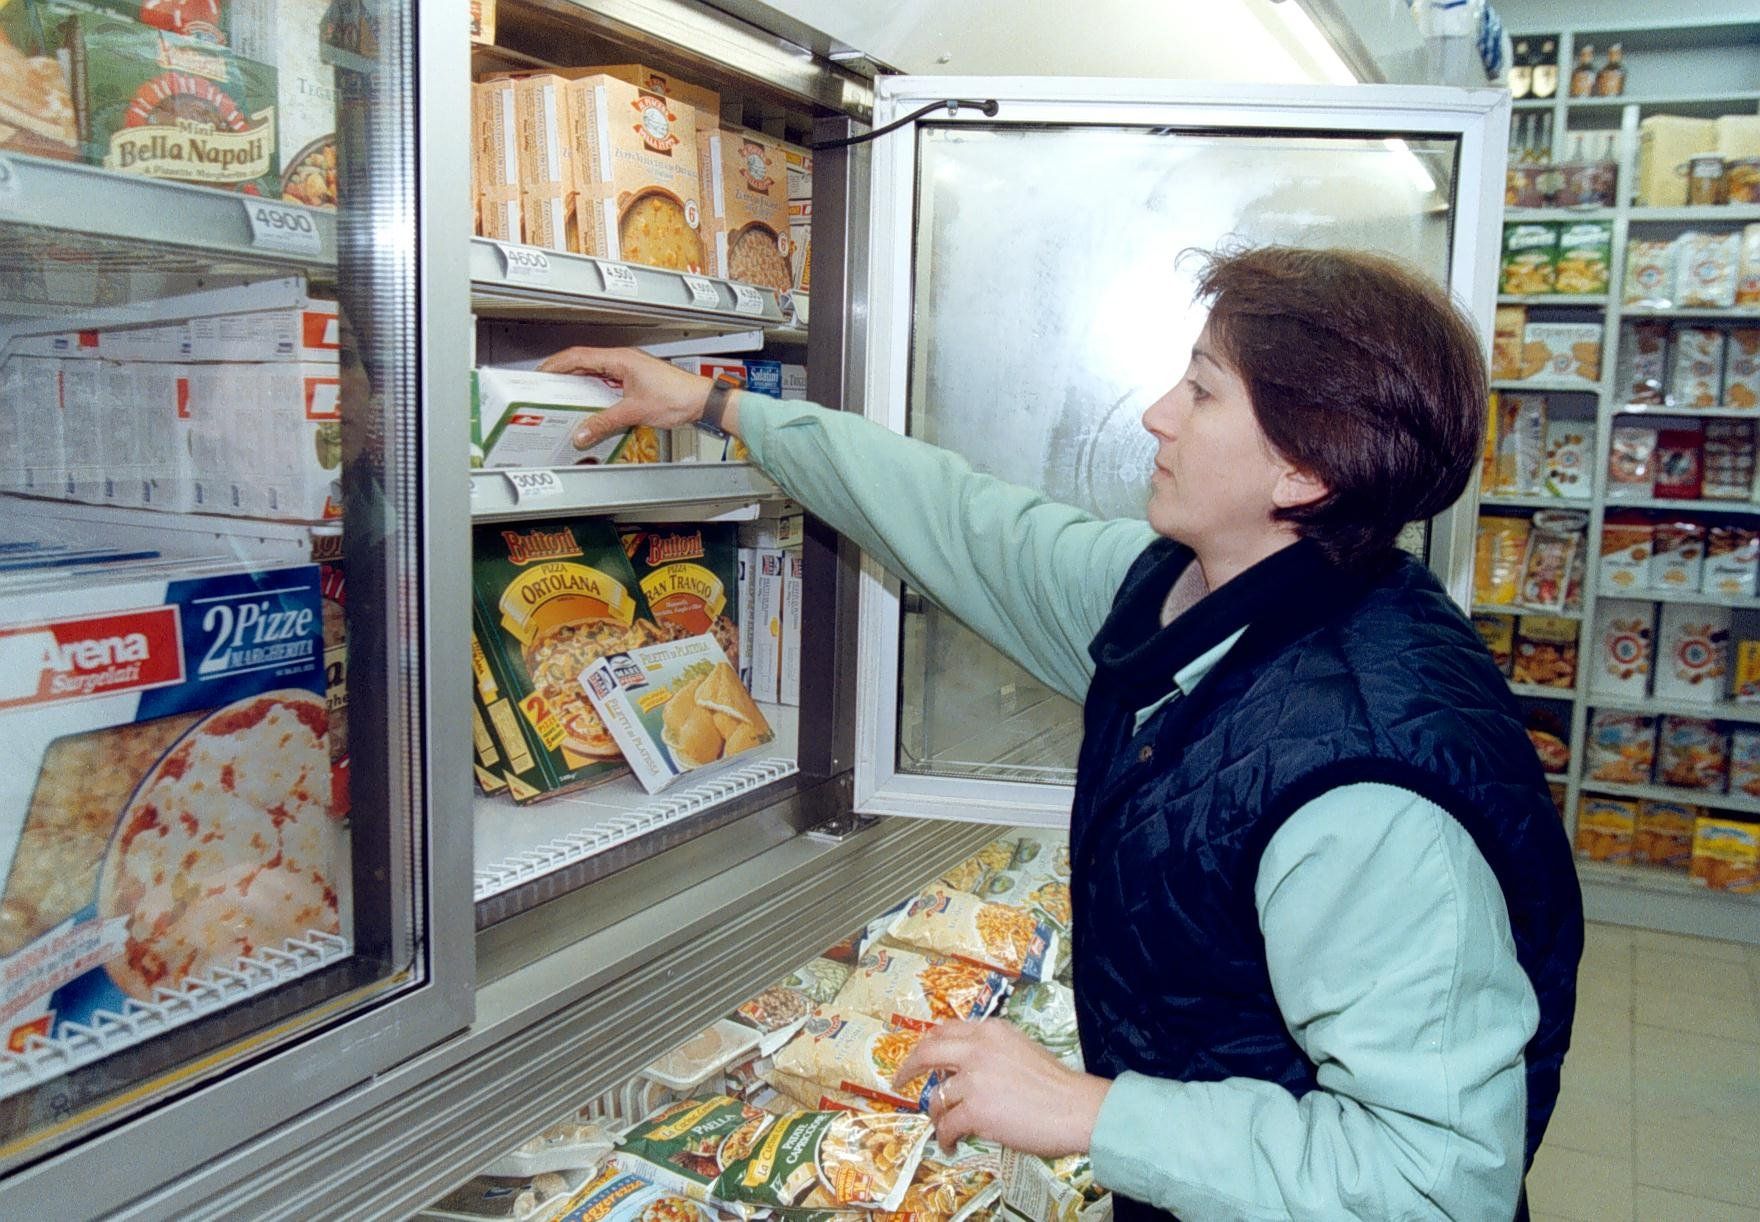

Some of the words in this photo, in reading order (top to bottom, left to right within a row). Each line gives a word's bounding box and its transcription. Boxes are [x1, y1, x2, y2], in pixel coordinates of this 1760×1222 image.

[180, 121, 214, 136] Mini
[119, 135, 183, 168] Bella
[187, 138, 263, 170] Napoli
[256, 207, 313, 233] 4900
[514, 473, 554, 488] 3000
[503, 527, 582, 563] Buitoni
[646, 530, 703, 564] Buitoni
[541, 563, 568, 575] PIZZA
[667, 564, 687, 574] PIZZA
[521, 574, 600, 604] ORTOLANA
[646, 581, 668, 602] RAN
[669, 573, 712, 599] TRANCIO
[42, 632, 149, 672] Arena
[198, 604, 235, 674] 2
[234, 602, 313, 647] Pizze
[230, 638, 313, 668] MARGHERITA
[639, 649, 671, 663] FILETTI
[527, 696, 552, 726] 2
[692, 1113, 737, 1136] PAELLA
[757, 1163, 771, 1177] La
